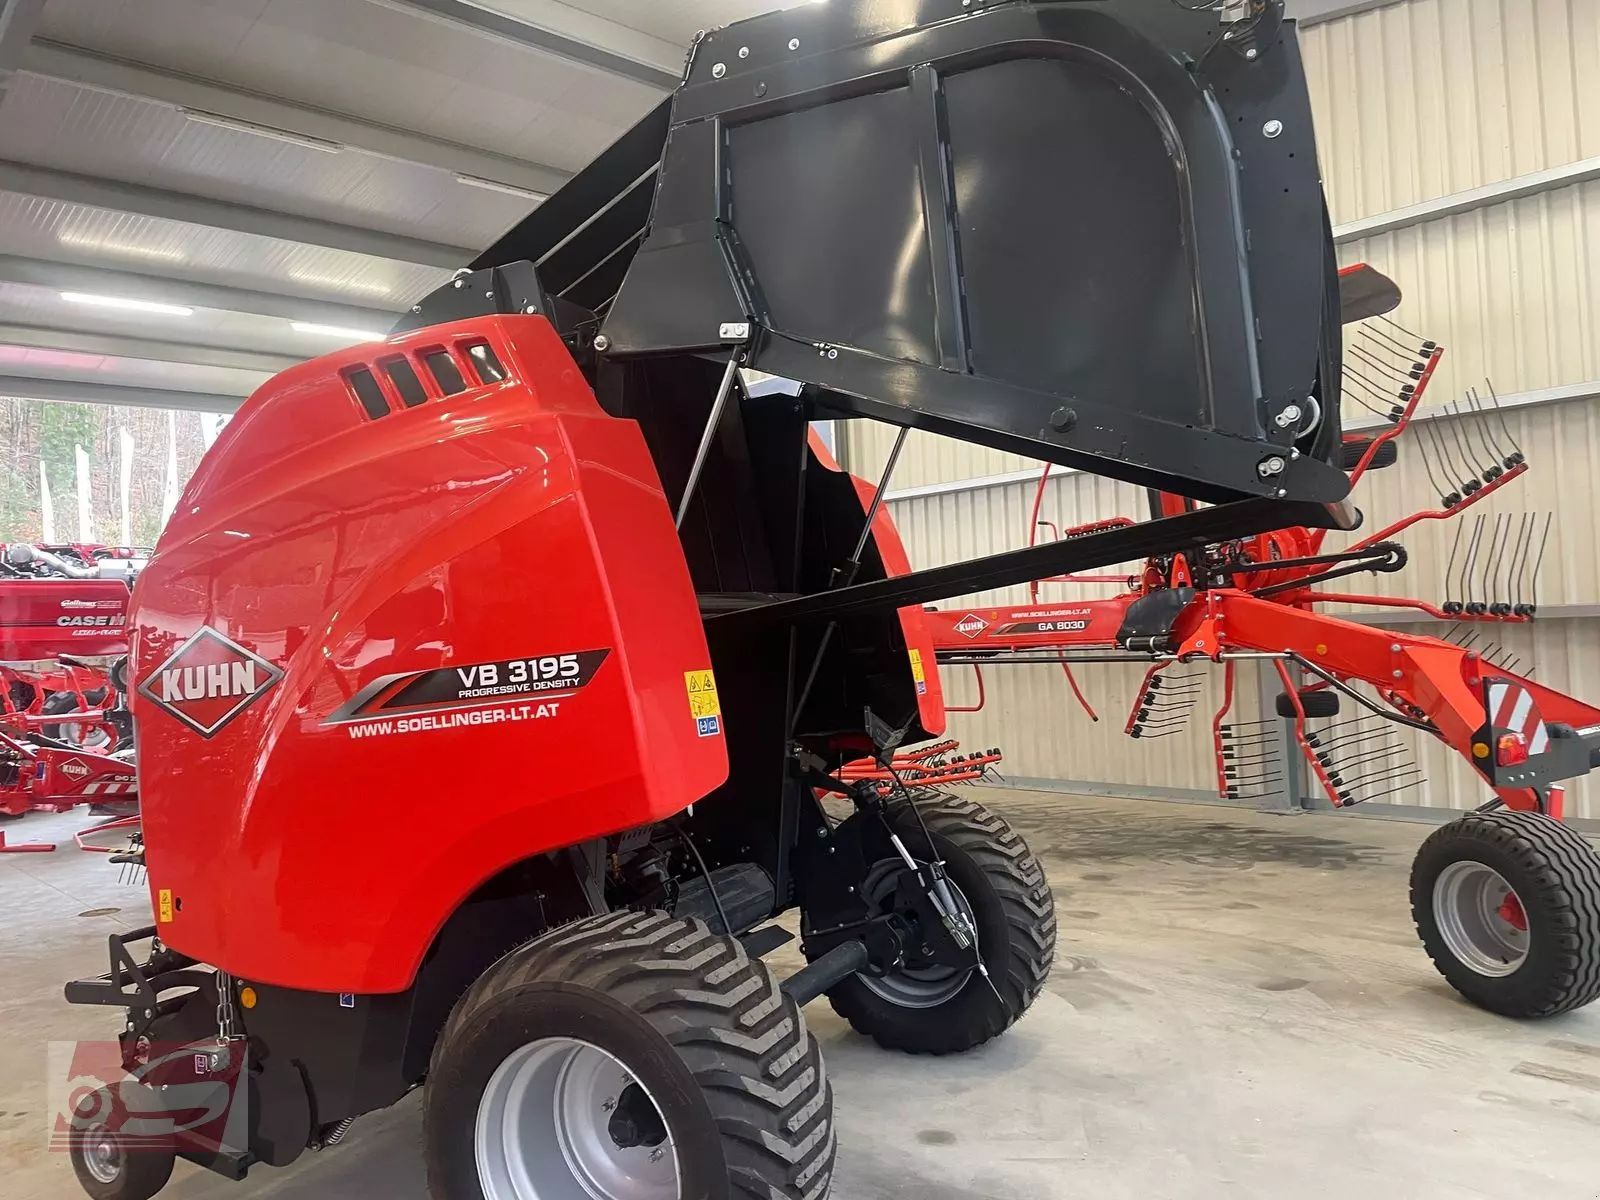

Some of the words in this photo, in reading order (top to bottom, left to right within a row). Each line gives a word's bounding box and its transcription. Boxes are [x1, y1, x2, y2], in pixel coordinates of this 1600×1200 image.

[57, 615, 108, 626] CASE
[959, 621, 983, 632] KUHN
[1038, 622, 1054, 631] GA
[1057, 620, 1085, 630] 8030
[457, 664, 499, 688] VB
[508, 654, 580, 683] 3195
[162, 660, 255, 702] KUHN
[458, 683, 531, 698] PROGRESSIVE
[533, 677, 580, 690] DENSITY
[348, 703, 560, 739] WWW.SOELLINGER-LT.AT
[62, 764, 88, 775] KUHN
